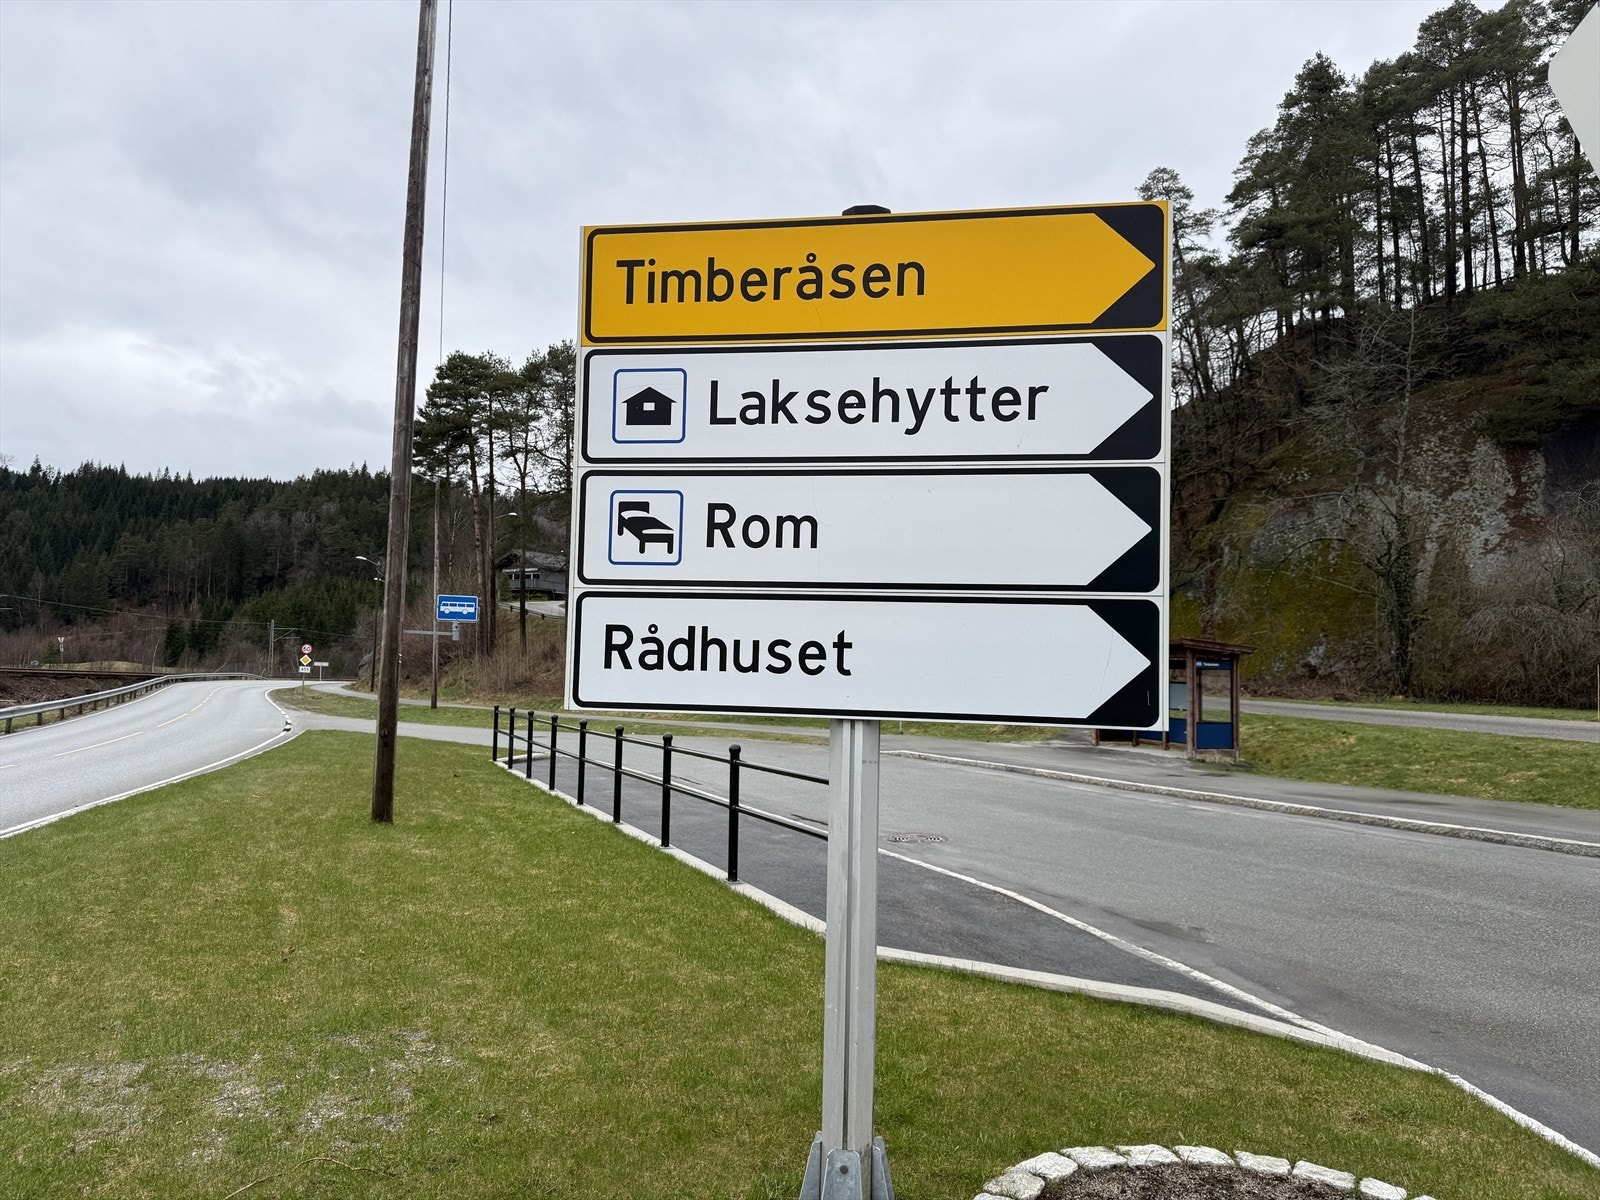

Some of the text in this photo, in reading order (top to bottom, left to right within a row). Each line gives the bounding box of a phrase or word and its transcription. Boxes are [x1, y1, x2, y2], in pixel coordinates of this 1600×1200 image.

[616, 252, 925, 304] Timberåsen
[709, 375, 1049, 436] Laksehytter
[706, 502, 818, 549] Rom
[603, 624, 853, 676] Rådhuset
